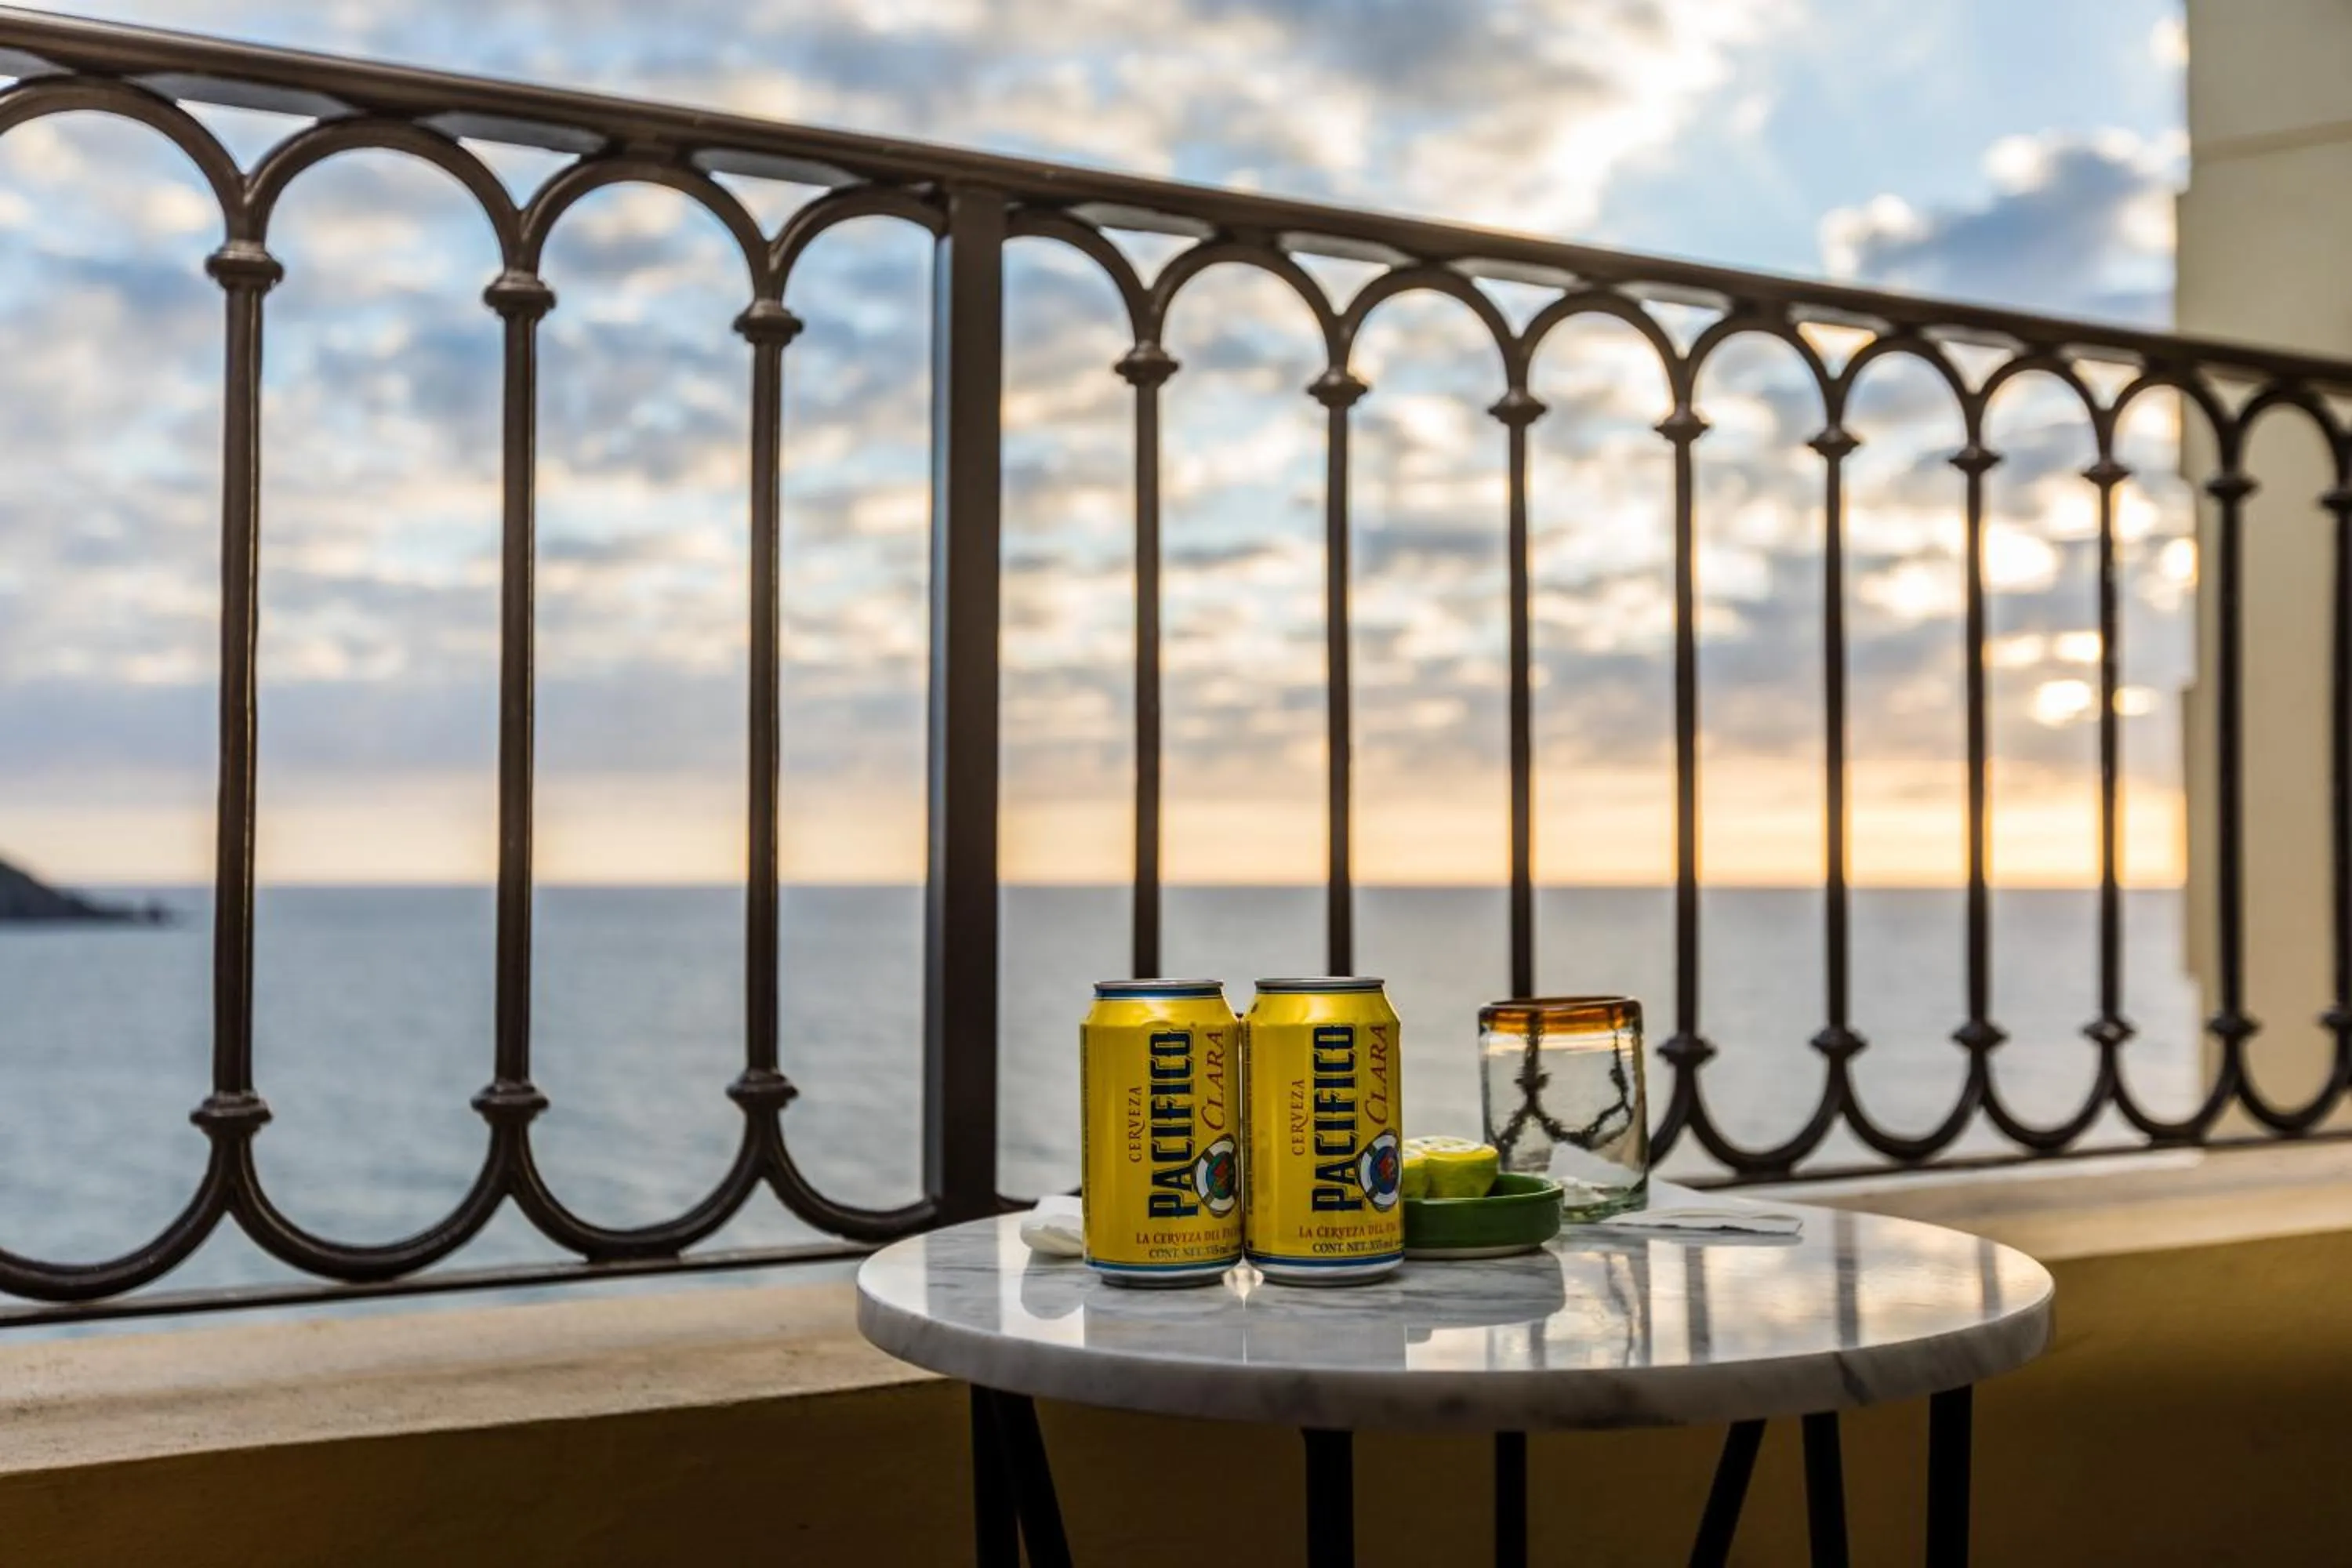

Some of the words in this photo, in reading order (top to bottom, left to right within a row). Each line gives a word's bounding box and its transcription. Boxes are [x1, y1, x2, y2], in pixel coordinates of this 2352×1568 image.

[1200, 1031, 1226, 1131] CLARA
[1291, 1079, 1308, 1156] CERVEZA
[1312, 1024, 1364, 1212] PACIFICO
[1364, 1023, 1391, 1125] CLARA
[1128, 1086, 1145, 1163] CERVEZA
[1149, 1029, 1200, 1218] PACIFICO
[1136, 1232, 1149, 1244] LA
[1153, 1231, 1202, 1245] CERVEZA
[1299, 1225, 1312, 1238] LA
[1316, 1225, 1365, 1239] CERVEZA
